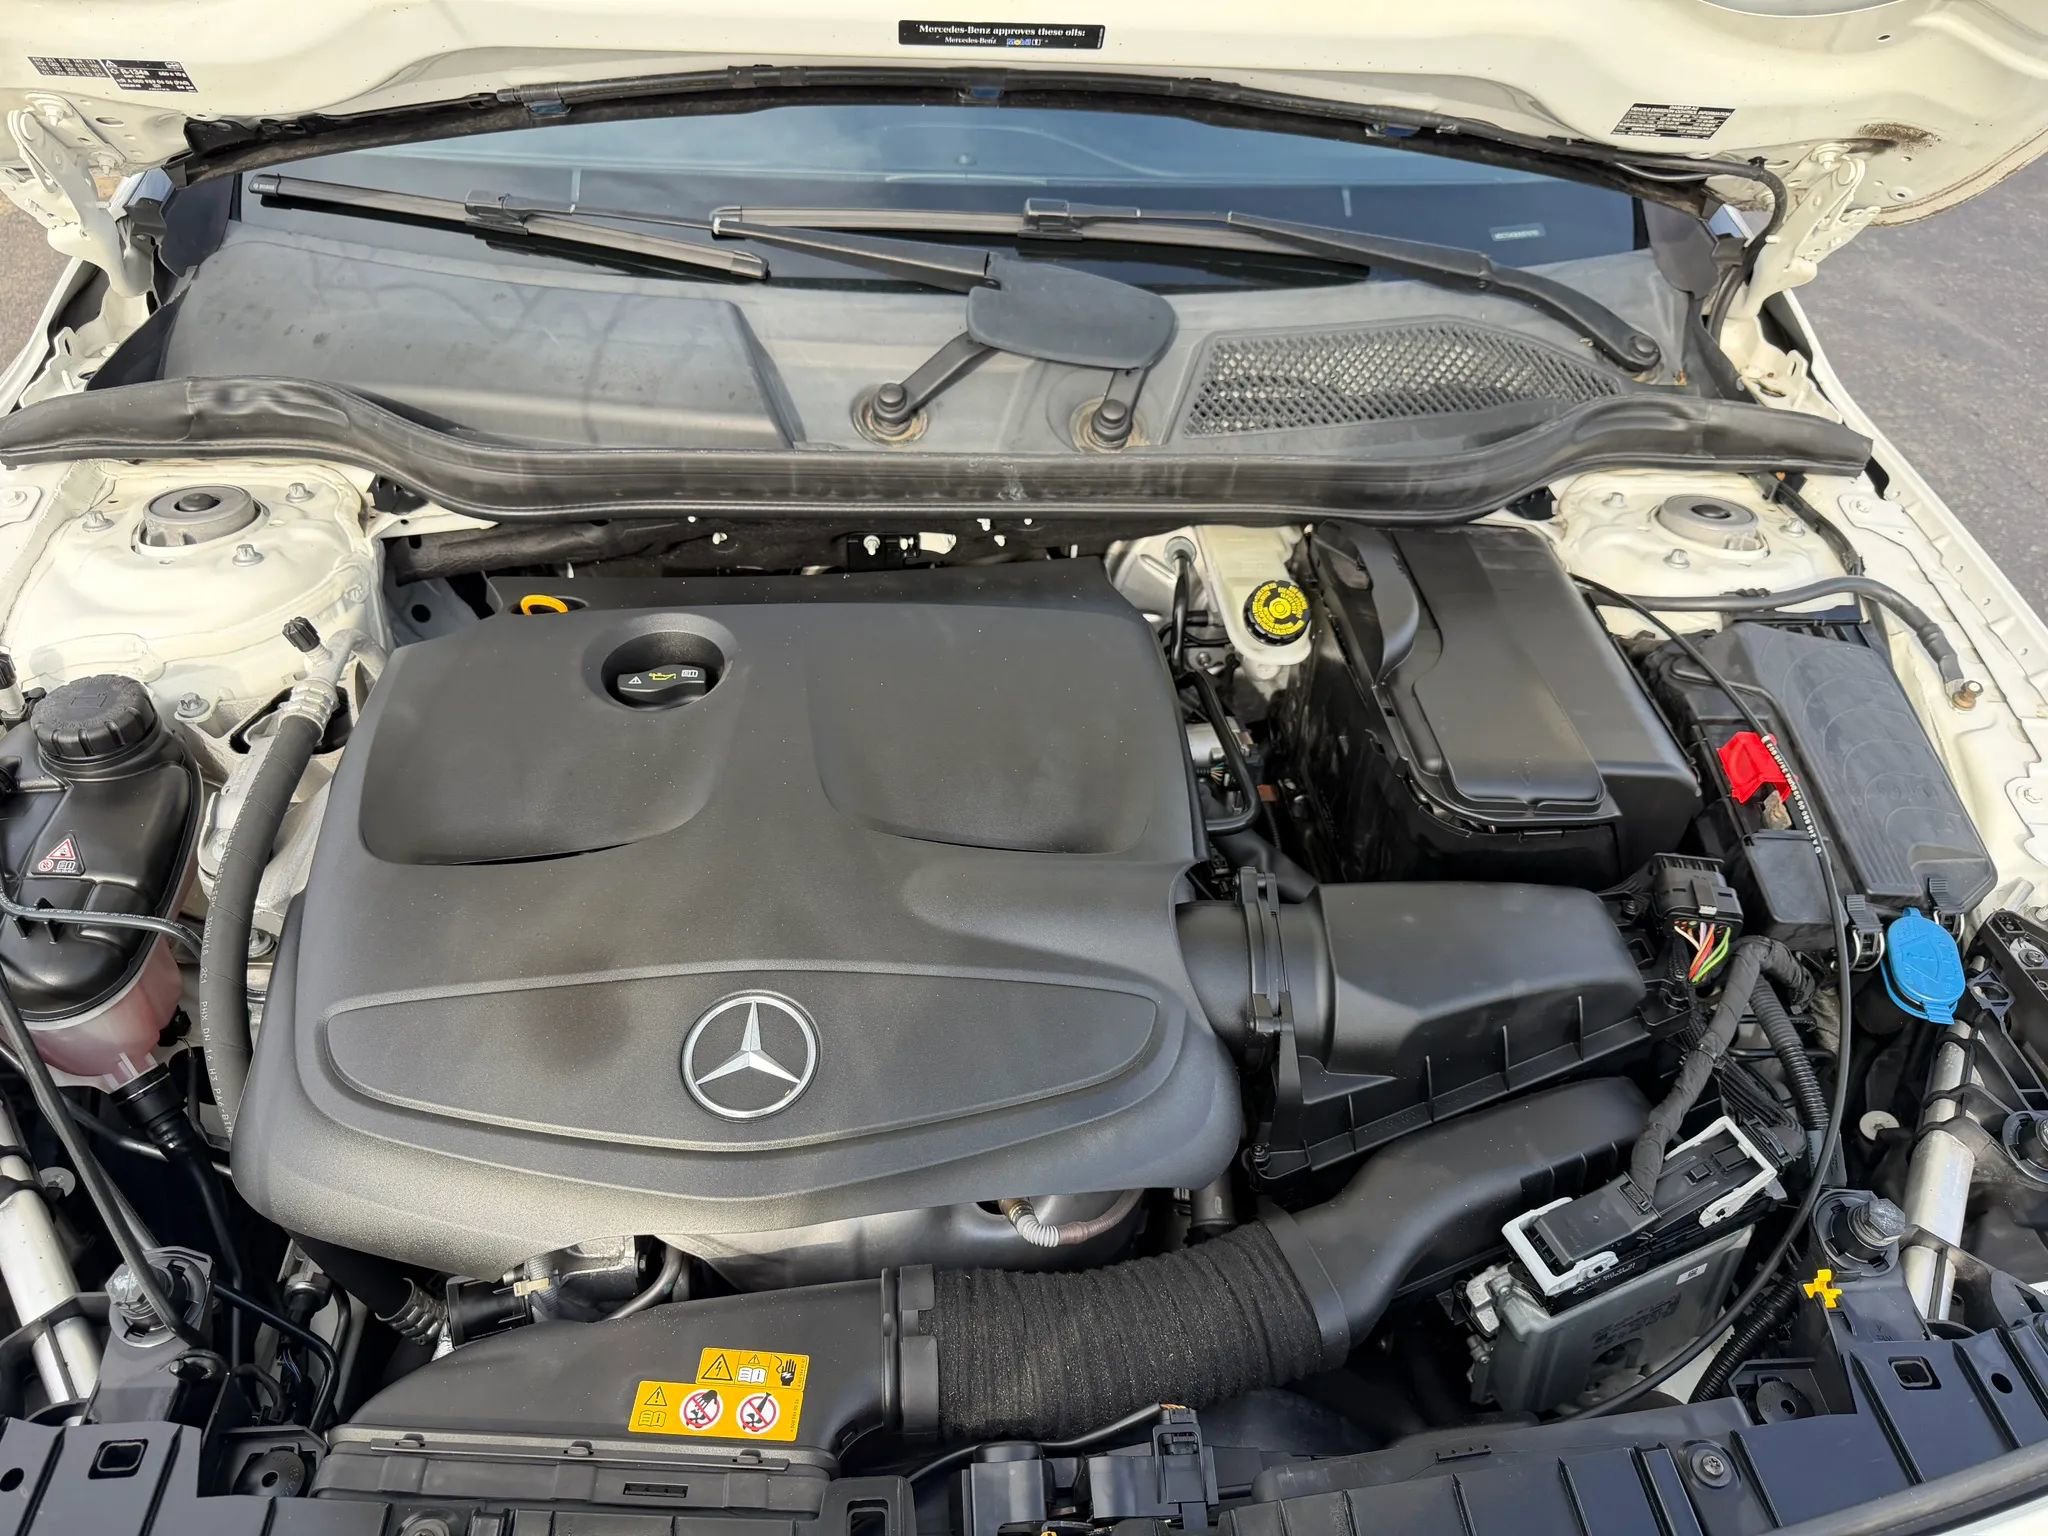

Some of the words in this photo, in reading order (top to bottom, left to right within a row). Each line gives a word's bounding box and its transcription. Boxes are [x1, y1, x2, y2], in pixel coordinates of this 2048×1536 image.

[918, 25, 991, 35] Mercedes-Benz
[993, 26, 1035, 37] approves
[1037, 26, 1063, 36] these
[1065, 27, 1086, 37] oils:
[944, 36, 997, 44] Mercedes-Benz
[200, 1001, 209, 1021] PHX
[202, 1028, 211, 1041] DN
[204, 1048, 212, 1062] 16
[207, 1068, 219, 1081] H3
